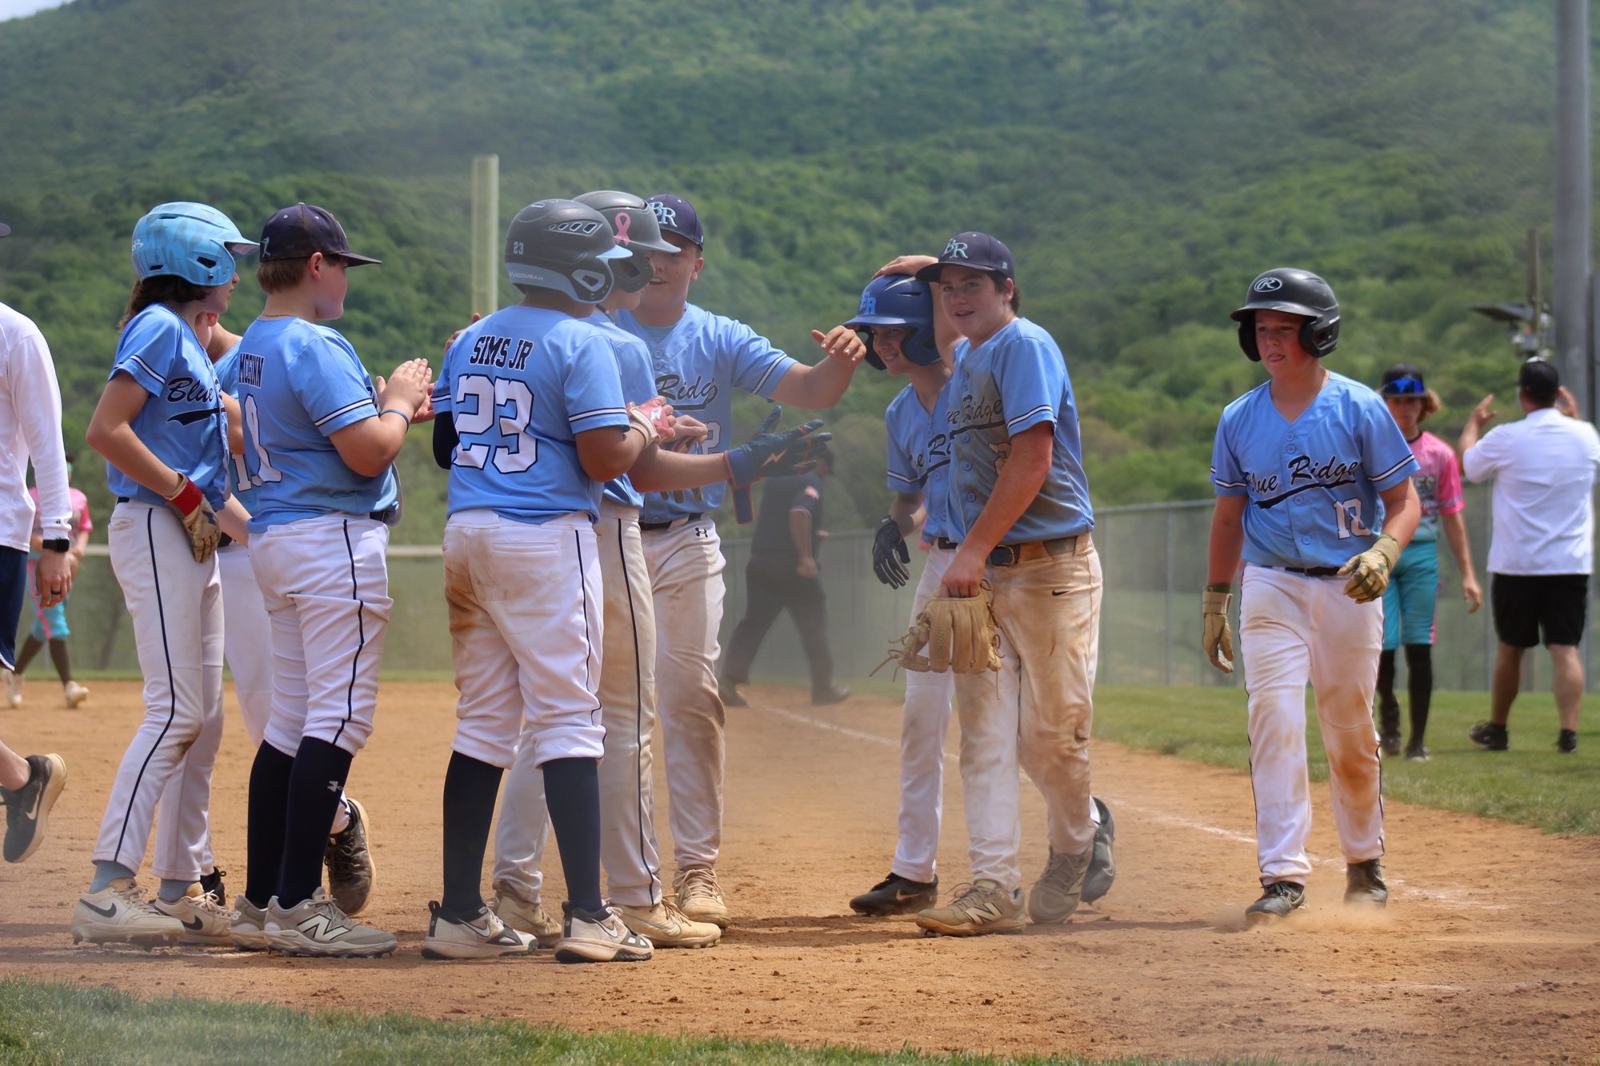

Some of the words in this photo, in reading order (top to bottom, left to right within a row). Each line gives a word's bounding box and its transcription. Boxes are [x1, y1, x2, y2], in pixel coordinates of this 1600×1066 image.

[512, 240, 525, 257] 23
[470, 335, 511, 368] SIMS
[508, 338, 534, 371] JR
[655, 373, 719, 406] Ridg
[453, 373, 538, 475] 23
[1288, 455, 1359, 485] Ridge
